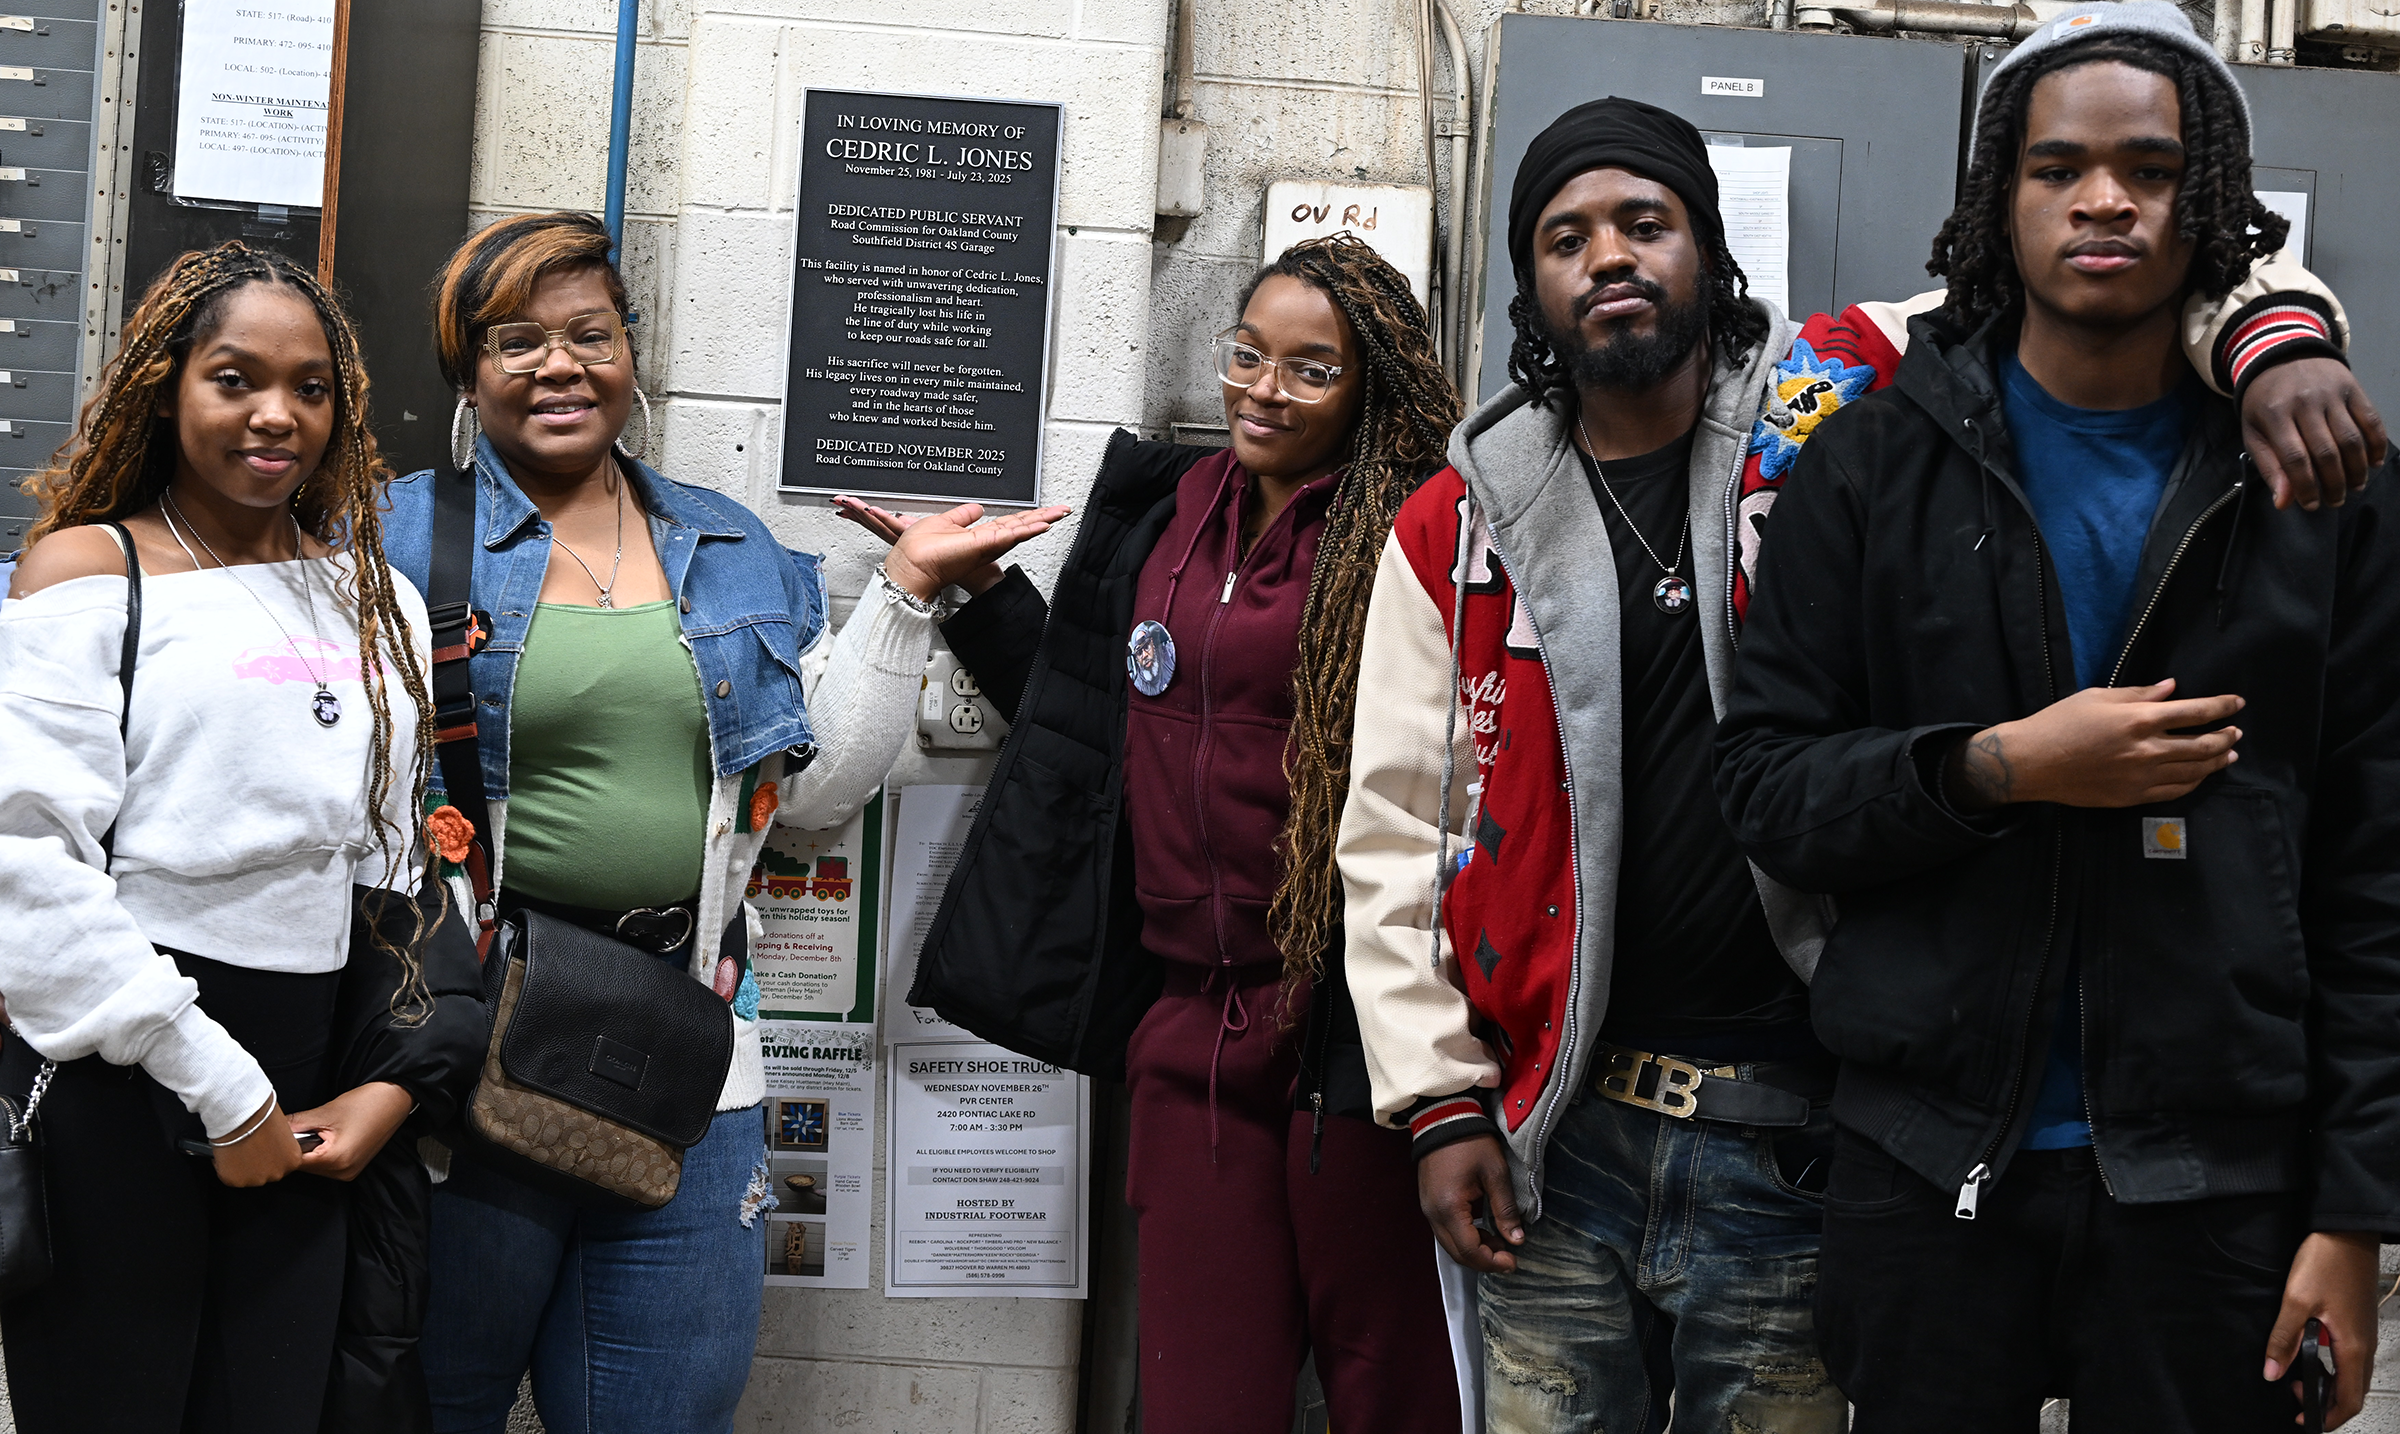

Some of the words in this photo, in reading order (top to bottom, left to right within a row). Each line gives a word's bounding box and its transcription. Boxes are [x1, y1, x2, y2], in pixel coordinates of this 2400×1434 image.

[235, 8, 265, 19] STATE:
[267, 11, 285, 20] 517-
[286, 13, 315, 24] (Road)-
[317, 16, 332, 24] 410
[233, 36, 276, 47] PRIMARY:
[278, 40, 296, 48] 472-
[297, 41, 315, 50] 095-
[316, 43, 331, 51] 410
[224, 62, 257, 73] LOCAL:
[259, 65, 277, 74] 502-
[278, 67, 321, 79] (Location)-
[1710, 81, 1744, 92] PANEL
[1746, 83, 1754, 92] B
[211, 92, 273, 104] NON-WINTER
[263, 107, 293, 117] WORK
[200, 117, 228, 125] STATE:
[230, 118, 246, 126] 517-
[247, 120, 299, 131] (LOCATION)-
[837, 114, 854, 127] IN
[859, 116, 922, 132] LOVING
[927, 120, 999, 137] MEMORY
[1004, 125, 1025, 139] OF
[199, 128, 240, 139] PRIMARY:
[241, 132, 258, 140] 467-
[259, 133, 276, 141] 095-
[277, 135, 324, 146] (ACTIVITY)
[199, 141, 230, 151] LOCAL:
[231, 144, 248, 152] 497-
[249, 146, 302, 157] (LOCATION)-
[826, 138, 919, 163] CEDRIC
[927, 145, 947, 165] L.
[956, 147, 1032, 170] JONES
[845, 163, 895, 175] November
[897, 166, 912, 178] 25,
[915, 168, 936, 178] 1981
[946, 170, 967, 182] July
[970, 171, 984, 183] 23,
[987, 172, 1011, 183] 2025
[828, 203, 906, 219] DEDICATED
[909, 209, 958, 223] PUBLIC
[961, 212, 1023, 227] SERVANT
[1291, 203, 1331, 224] OV
[1342, 204, 1377, 231] Rd
[830, 218, 855, 230] Road
[858, 220, 918, 234] Commission
[922, 224, 936, 235] for
[938, 226, 979, 238] Oakland
[982, 228, 1018, 243] County
[852, 233, 902, 246] Southfield
[905, 237, 941, 249] District
[944, 240, 957, 250] 4S
[960, 241, 995, 255] Garage
[800, 257, 822, 268] This
[825, 259, 859, 273] facility
[862, 262, 870, 272] is
[873, 264, 905, 274] named
[908, 265, 918, 275] in
[921, 266, 949, 277] honor
[951, 268, 964, 278] of
[964, 269, 997, 280] Cedric
[1000, 271, 1010, 281] L.
[1013, 272, 1043, 284] Jones,
[823, 273, 844, 284] who
[847, 276, 879, 286] served
[882, 277, 903, 287] with
[906, 281, 963, 294] unwavering
[965, 282, 1018, 297] dedication,
[857, 290, 932, 303] professionalism
[935, 295, 953, 304] and
[956, 295, 983, 306] heart.
[827, 355, 844, 366] His
[846, 358, 889, 369] sacrifice
[891, 360, 910, 370] will
[913, 364, 941, 372] never
[943, 363, 955, 373] be
[958, 364, 1004, 377] forgotten.
[805, 368, 822, 378] His
[825, 369, 857, 382] legacy
[859, 371, 882, 382] lives
[884, 375, 897, 383] on
[900, 374, 910, 384] in
[912, 377, 940, 388] every
[943, 377, 965, 387] mile
[967, 379, 1024, 393] maintained,
[816, 438, 894, 453] DEDICATED
[897, 443, 973, 459] NOVEMBER
[977, 448, 1005, 461] 2025
[815, 453, 840, 464] Road
[843, 455, 903, 468] Commission
[907, 459, 921, 469] for
[923, 460, 964, 472] Oakland
[967, 463, 1003, 477] County
[769, 906, 816, 915] unwrapped
[817, 907, 835, 916] toys
[788, 914, 819, 923] holiday
[792, 942, 833, 953] Receiving
[756, 951, 789, 962] Monday,
[789, 952, 829, 962] December
[828, 954, 842, 963] 8th
[777, 970, 796, 978] Cash
[798, 971, 837, 980] Donation?
[812, 1046, 862, 1062] RAFFLE
[909, 1061, 964, 1073] SAFETY
[966, 1060, 1008, 1073] SHOE
[1011, 1061, 1062, 1074] TRUCK
[981, 1084, 1030, 1092] NOVEMBER
[959, 1097, 977, 1105] PVR
[978, 1097, 1013, 1105] CENTER
[937, 1110, 958, 1118] 2420
[958, 1110, 997, 1118] PONTIAC
[999, 1110, 1021, 1118] LAKE
[1023, 1110, 1036, 1118] RD
[949, 1123, 968, 1131] 7:00
[968, 1123, 983, 1131] AM
[989, 1123, 1008, 1131] 3:30
[1009, 1123, 1023, 1131] PM
[938, 1166, 953, 1174] YOU
[956, 1199, 999, 1207] HOSTED
[1001, 1199, 1015, 1207] BY
[925, 1211, 986, 1219] INDUSTRIAL
[989, 1211, 1046, 1220] FOOTWEAR
